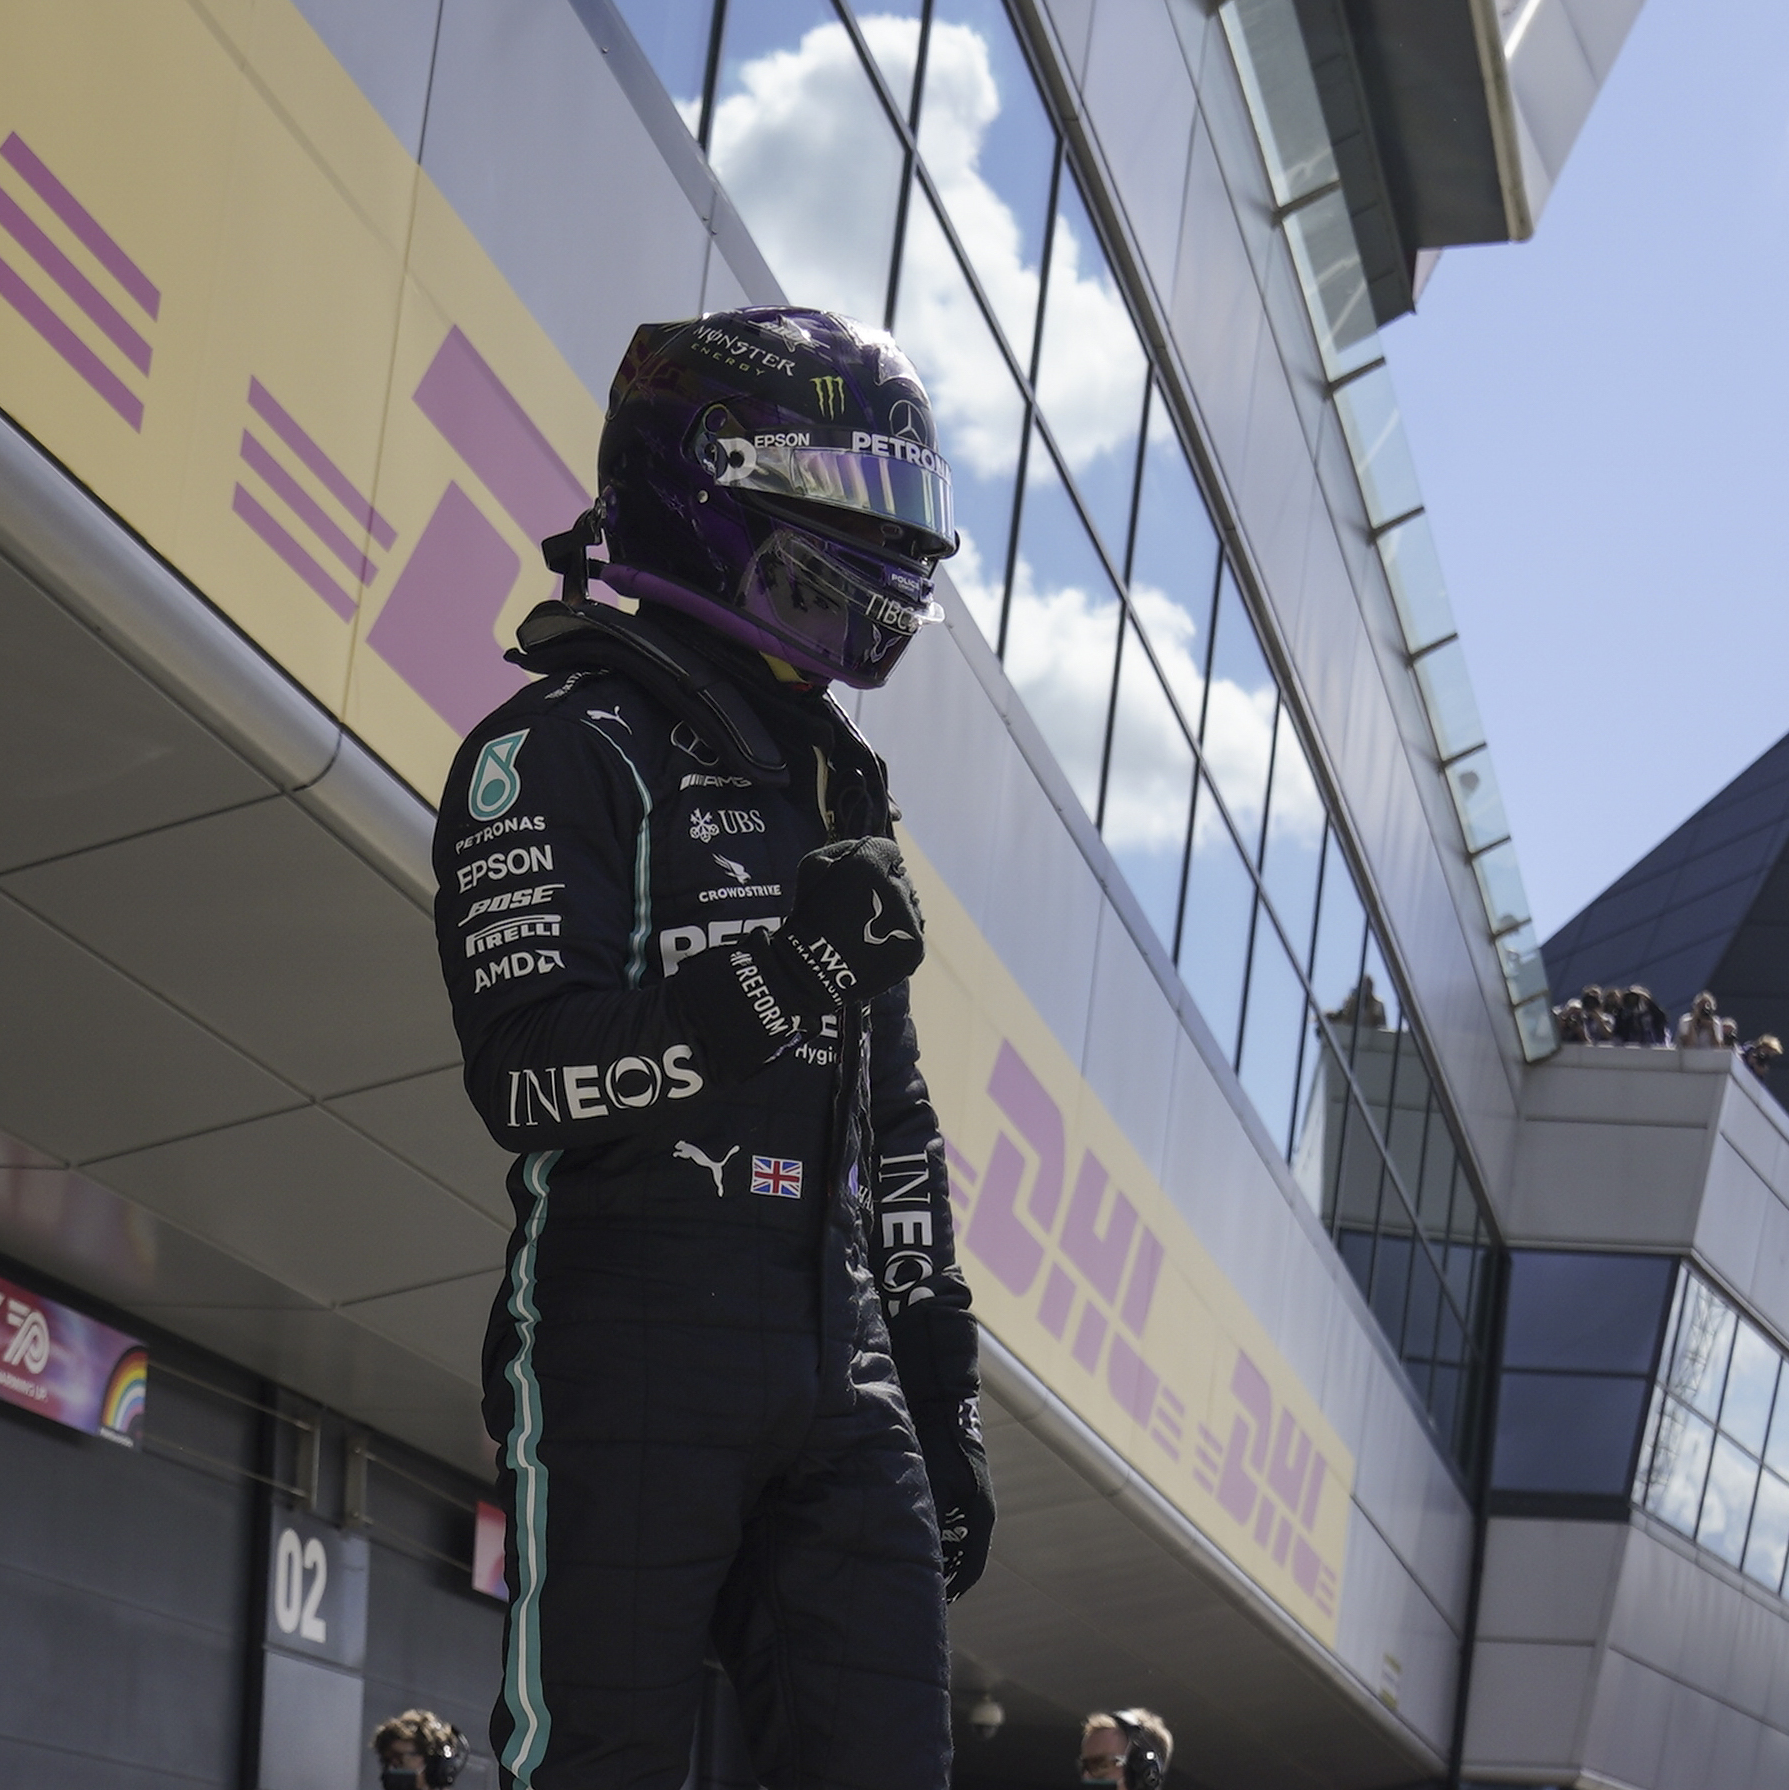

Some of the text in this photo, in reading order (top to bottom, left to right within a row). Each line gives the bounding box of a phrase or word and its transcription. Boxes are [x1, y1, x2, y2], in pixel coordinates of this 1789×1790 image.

[691, 343, 765, 377] ENERGY
[693, 325, 796, 377] MONSTER
[754, 433, 810, 449] EPSON
[455, 815, 547, 854] PETRONAS
[719, 809, 766, 836] UBS
[457, 845, 554, 893] EPSON
[458, 884, 565, 926] BOSE
[699, 884, 782, 903] CROWDSTRIKE
[465, 914, 562, 958] PIRELLI
[473, 952, 535, 993] AMD
[809, 937, 857, 990] IWC
[507, 1044, 704, 1127] INEOS
[274, 1528, 327, 1643] 02
